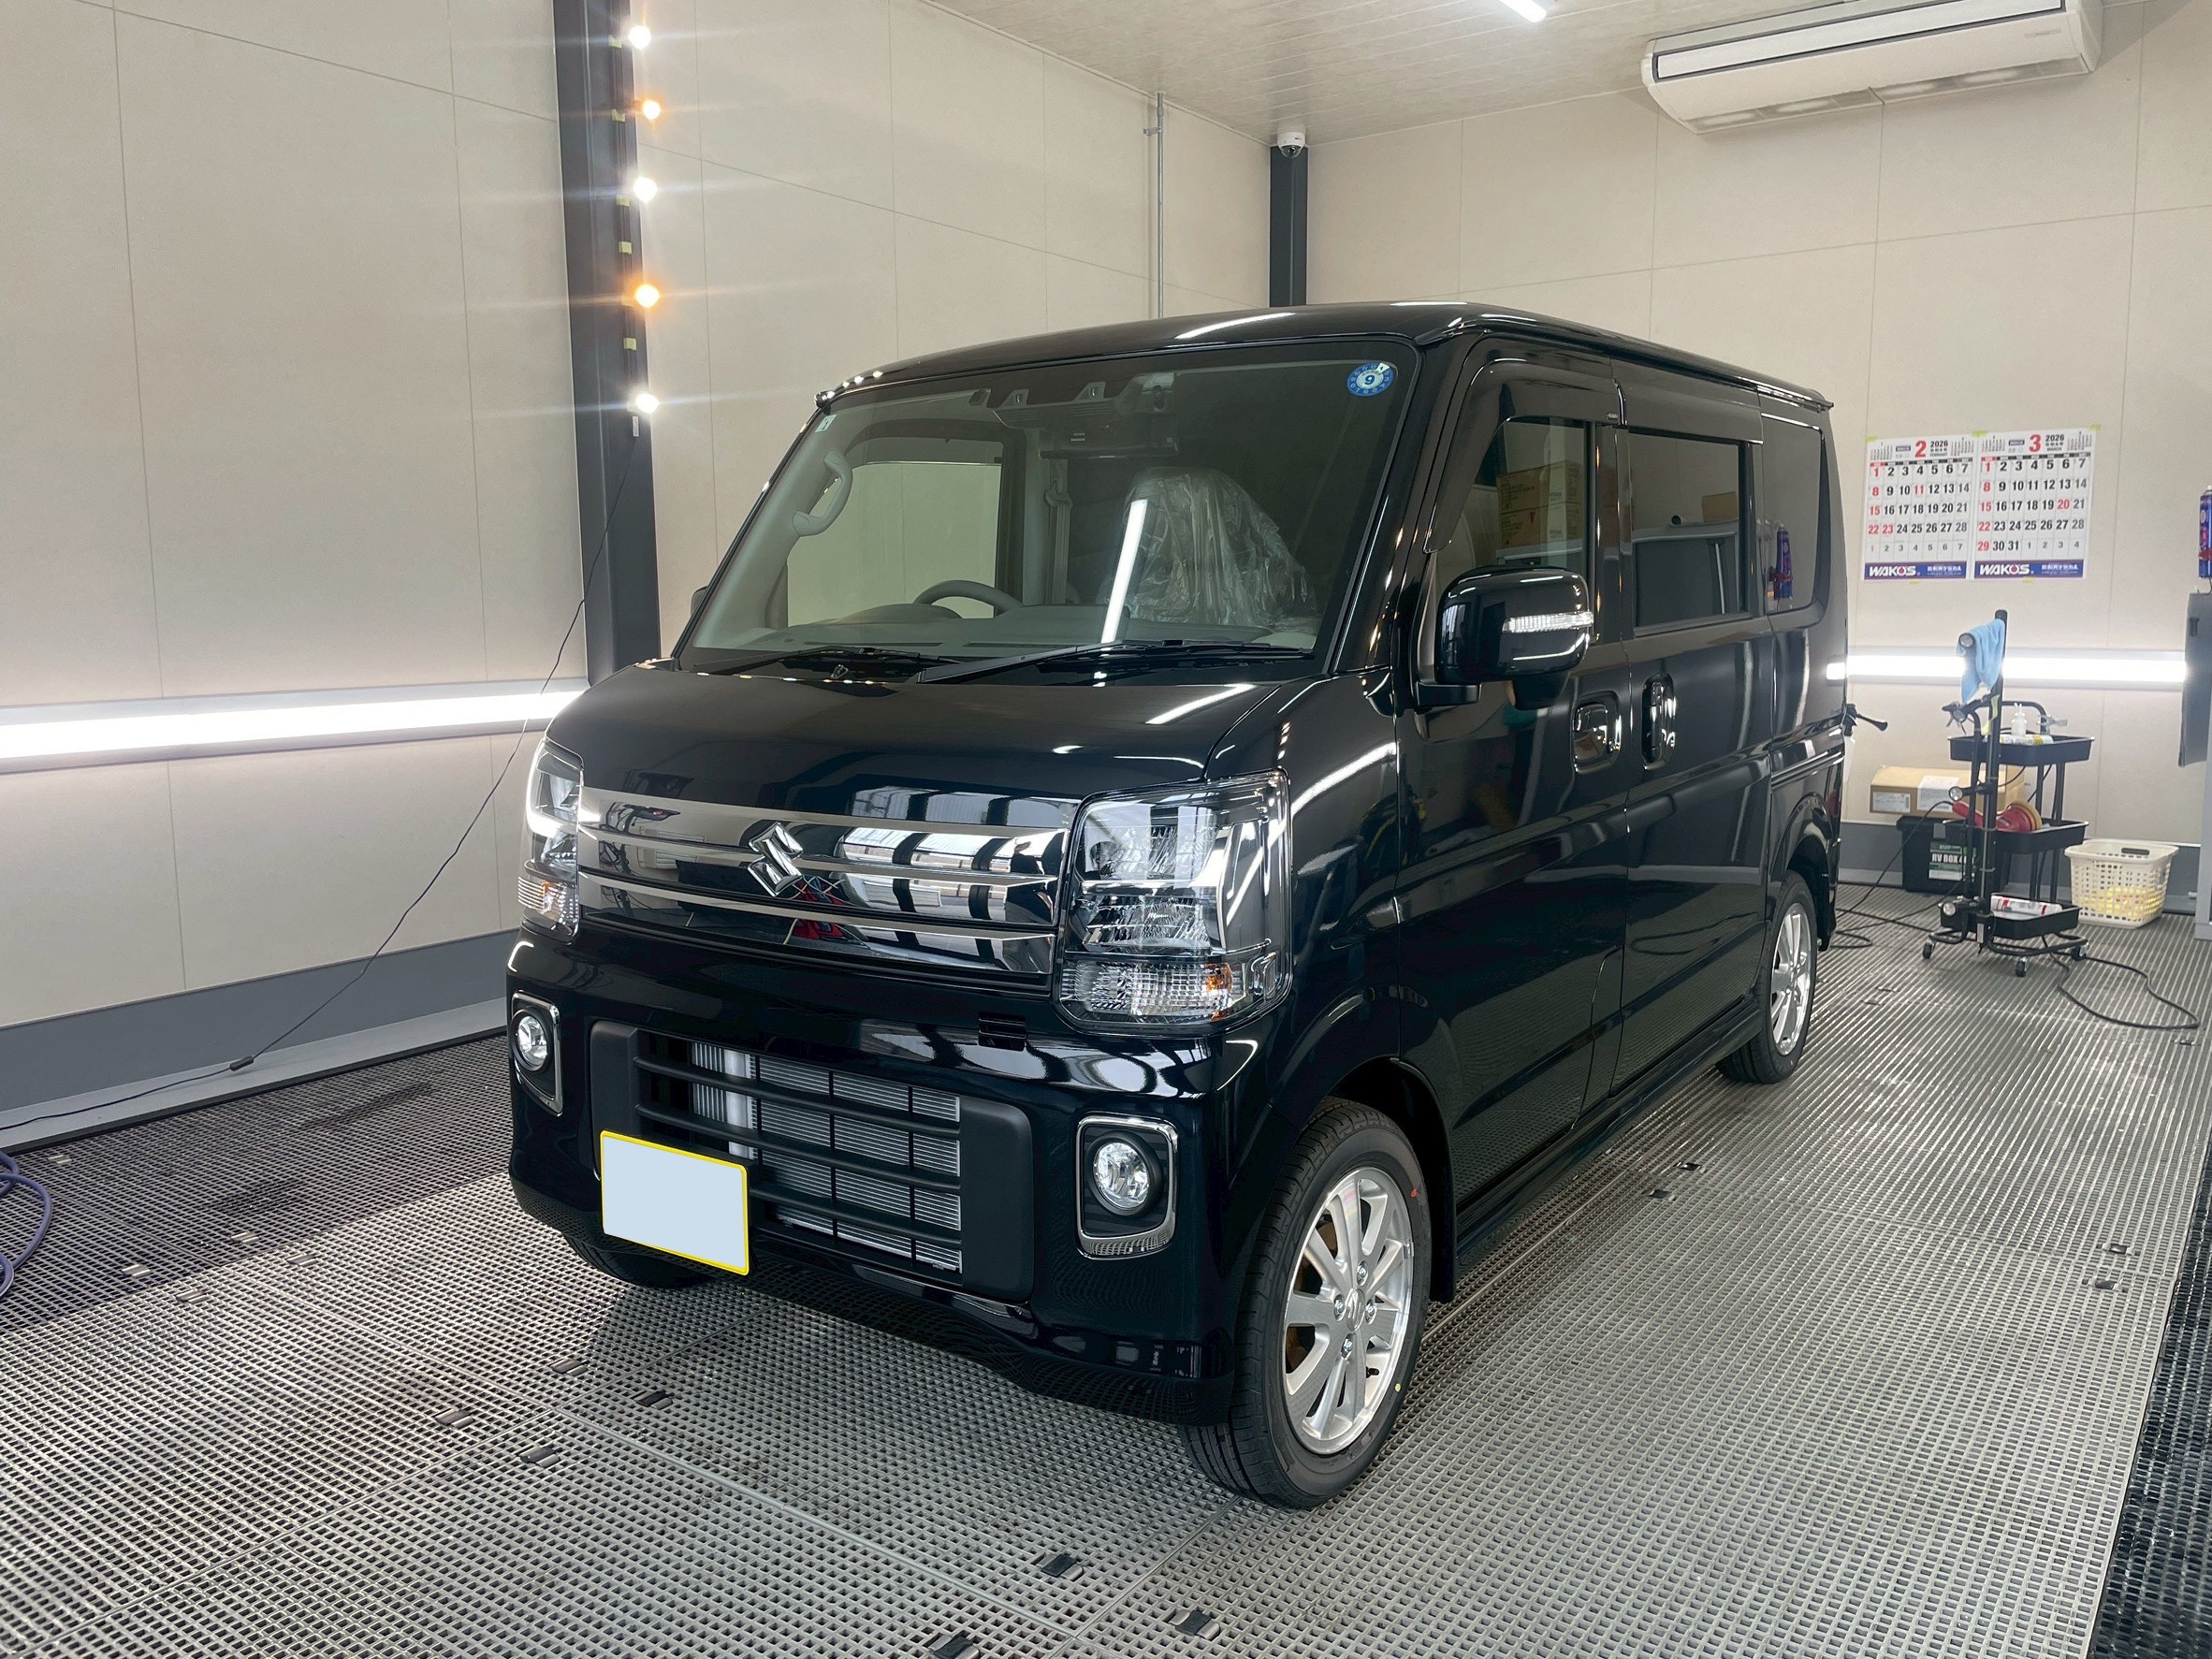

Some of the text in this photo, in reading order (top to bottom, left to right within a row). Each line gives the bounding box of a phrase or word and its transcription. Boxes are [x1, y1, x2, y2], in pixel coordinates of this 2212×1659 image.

[1364, 375, 1375, 385] 9
[2030, 434, 2041, 452] 3
[1915, 441, 1927, 458] 2
[1874, 464, 1968, 476] 1 2 3 4 5 6 7
[1986, 458, 2086, 472] 1 2 3 4 5 6 7
[1872, 483, 1970, 496] 8 9 10 11 12 13 14
[1984, 479, 2087, 491] 8 9 10 11 12 13 14
[1870, 502, 1967, 515] 15 16 17 18 19 20 21
[1981, 500, 2085, 511] 15 16 17 18 19 20 21
[1869, 523, 1967, 534] 22 23 24 25 26 27 28
[1979, 519, 2084, 531] 22 23 24 25 26 27 28
[1978, 542, 1989, 550] 29
[1993, 542, 2004, 550] 30
[2008, 541, 2019, 550] 31
